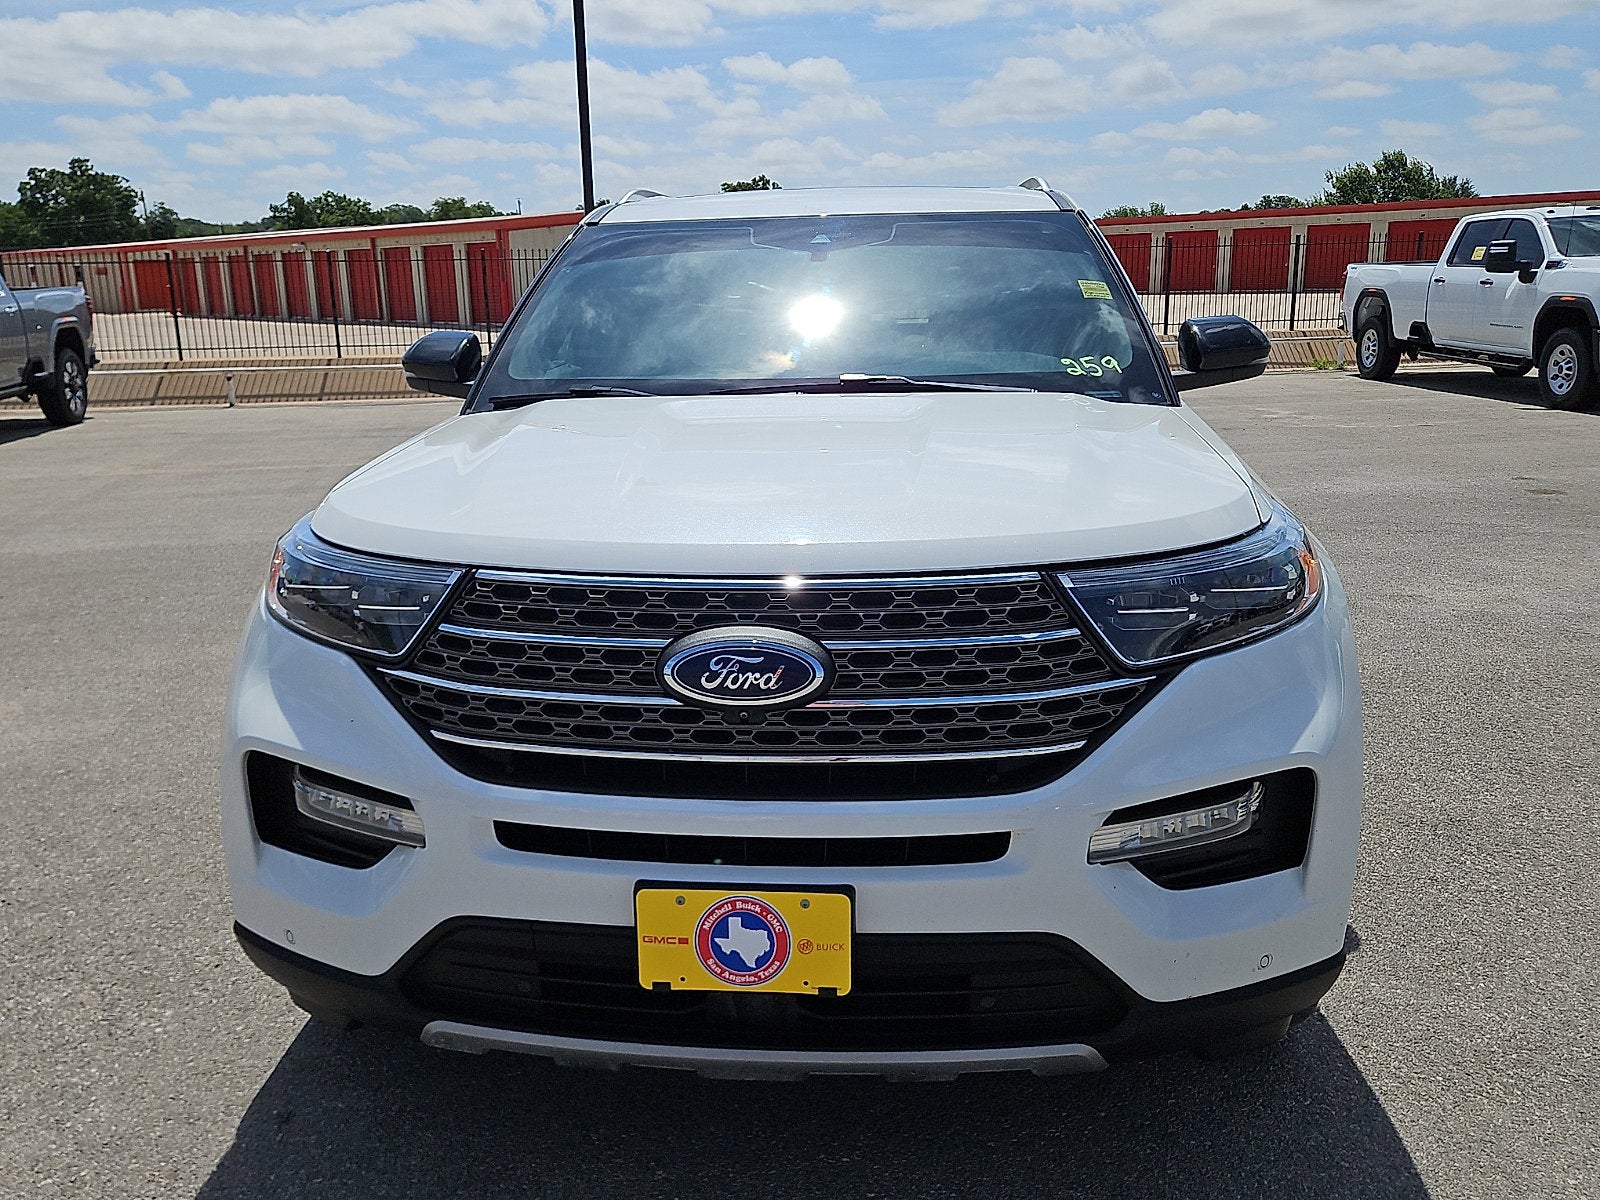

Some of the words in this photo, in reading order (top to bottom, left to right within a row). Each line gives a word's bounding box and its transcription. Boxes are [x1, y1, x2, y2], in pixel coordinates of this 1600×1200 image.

[1060, 355, 1123, 377] 259
[701, 654, 785, 690] Ford
[703, 903, 733, 931] Mitchell
[735, 901, 762, 914] Buick
[766, 913, 784, 933] GMC
[642, 935, 677, 945] GMC
[816, 943, 845, 951] BUICK
[706, 958, 721, 974] San
[721, 969, 759, 983] Angelo,
[758, 960, 781, 981] Texas
